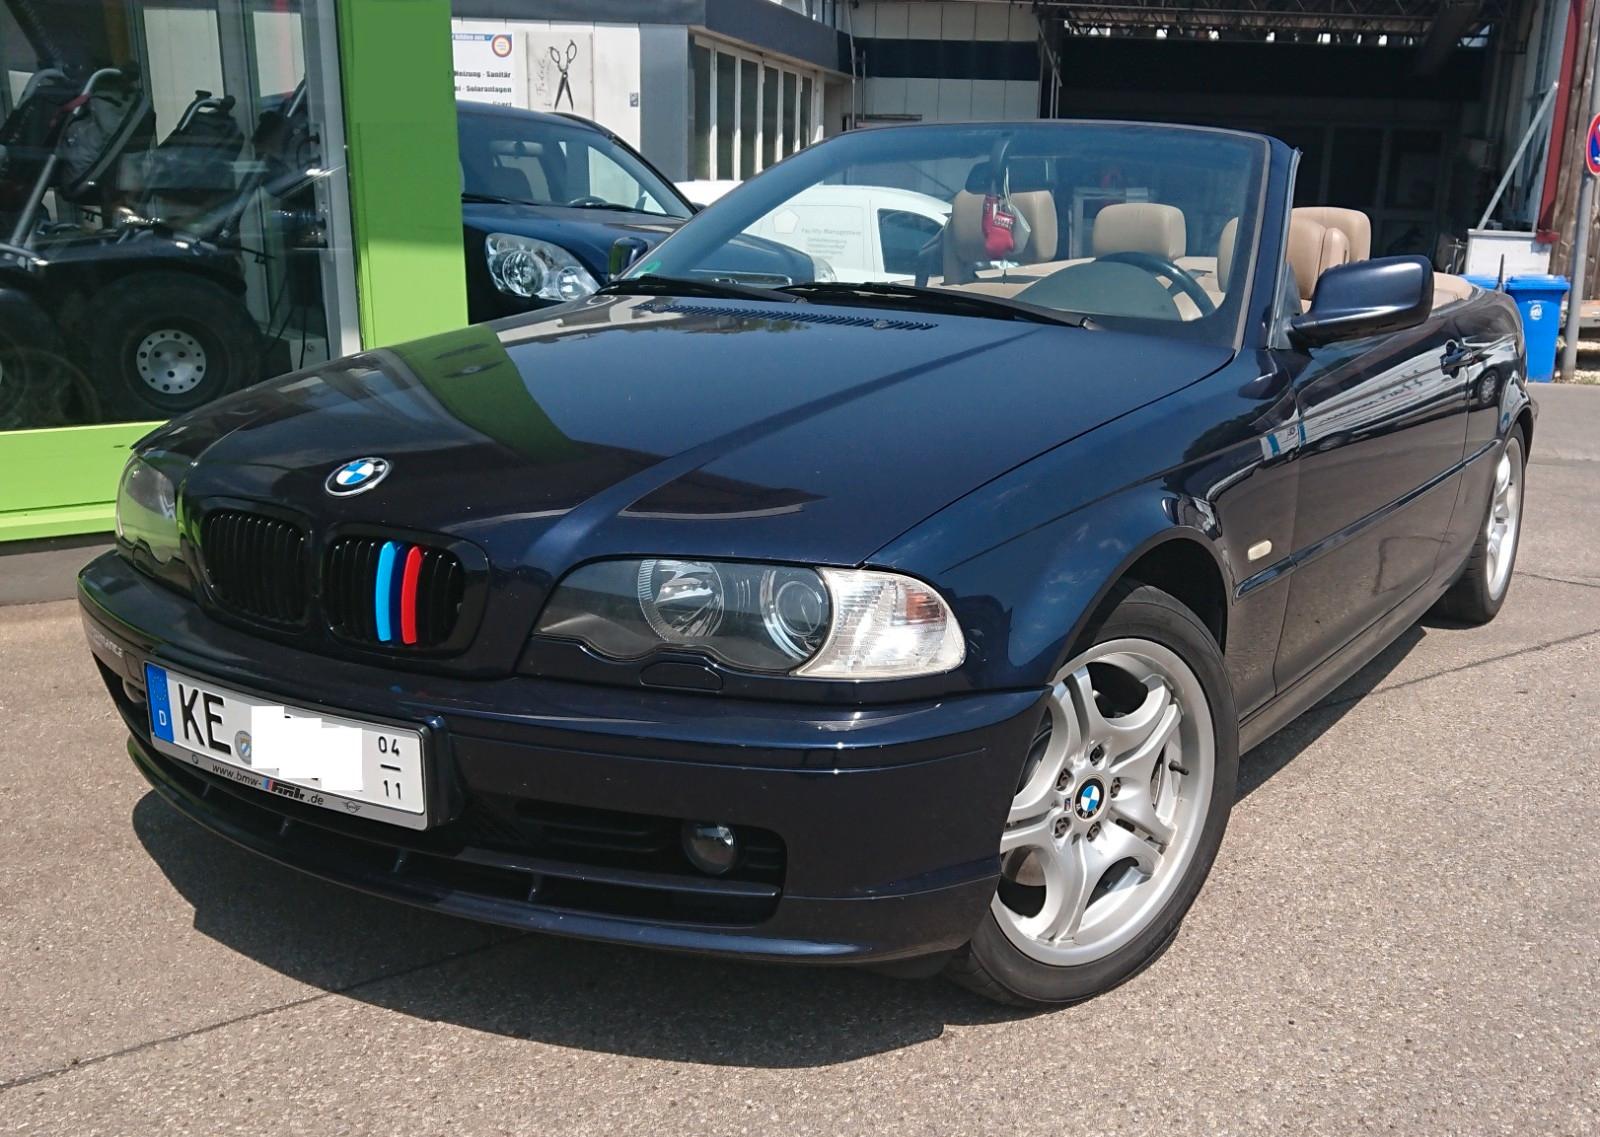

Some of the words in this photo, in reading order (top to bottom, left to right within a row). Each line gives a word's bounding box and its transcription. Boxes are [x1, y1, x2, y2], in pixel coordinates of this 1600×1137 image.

[466, 85, 512, 93] Solaranlagen
[159, 709, 167, 726] D
[178, 683, 232, 755] KE
[378, 736, 400, 756] 04
[383, 779, 401, 800] 11
